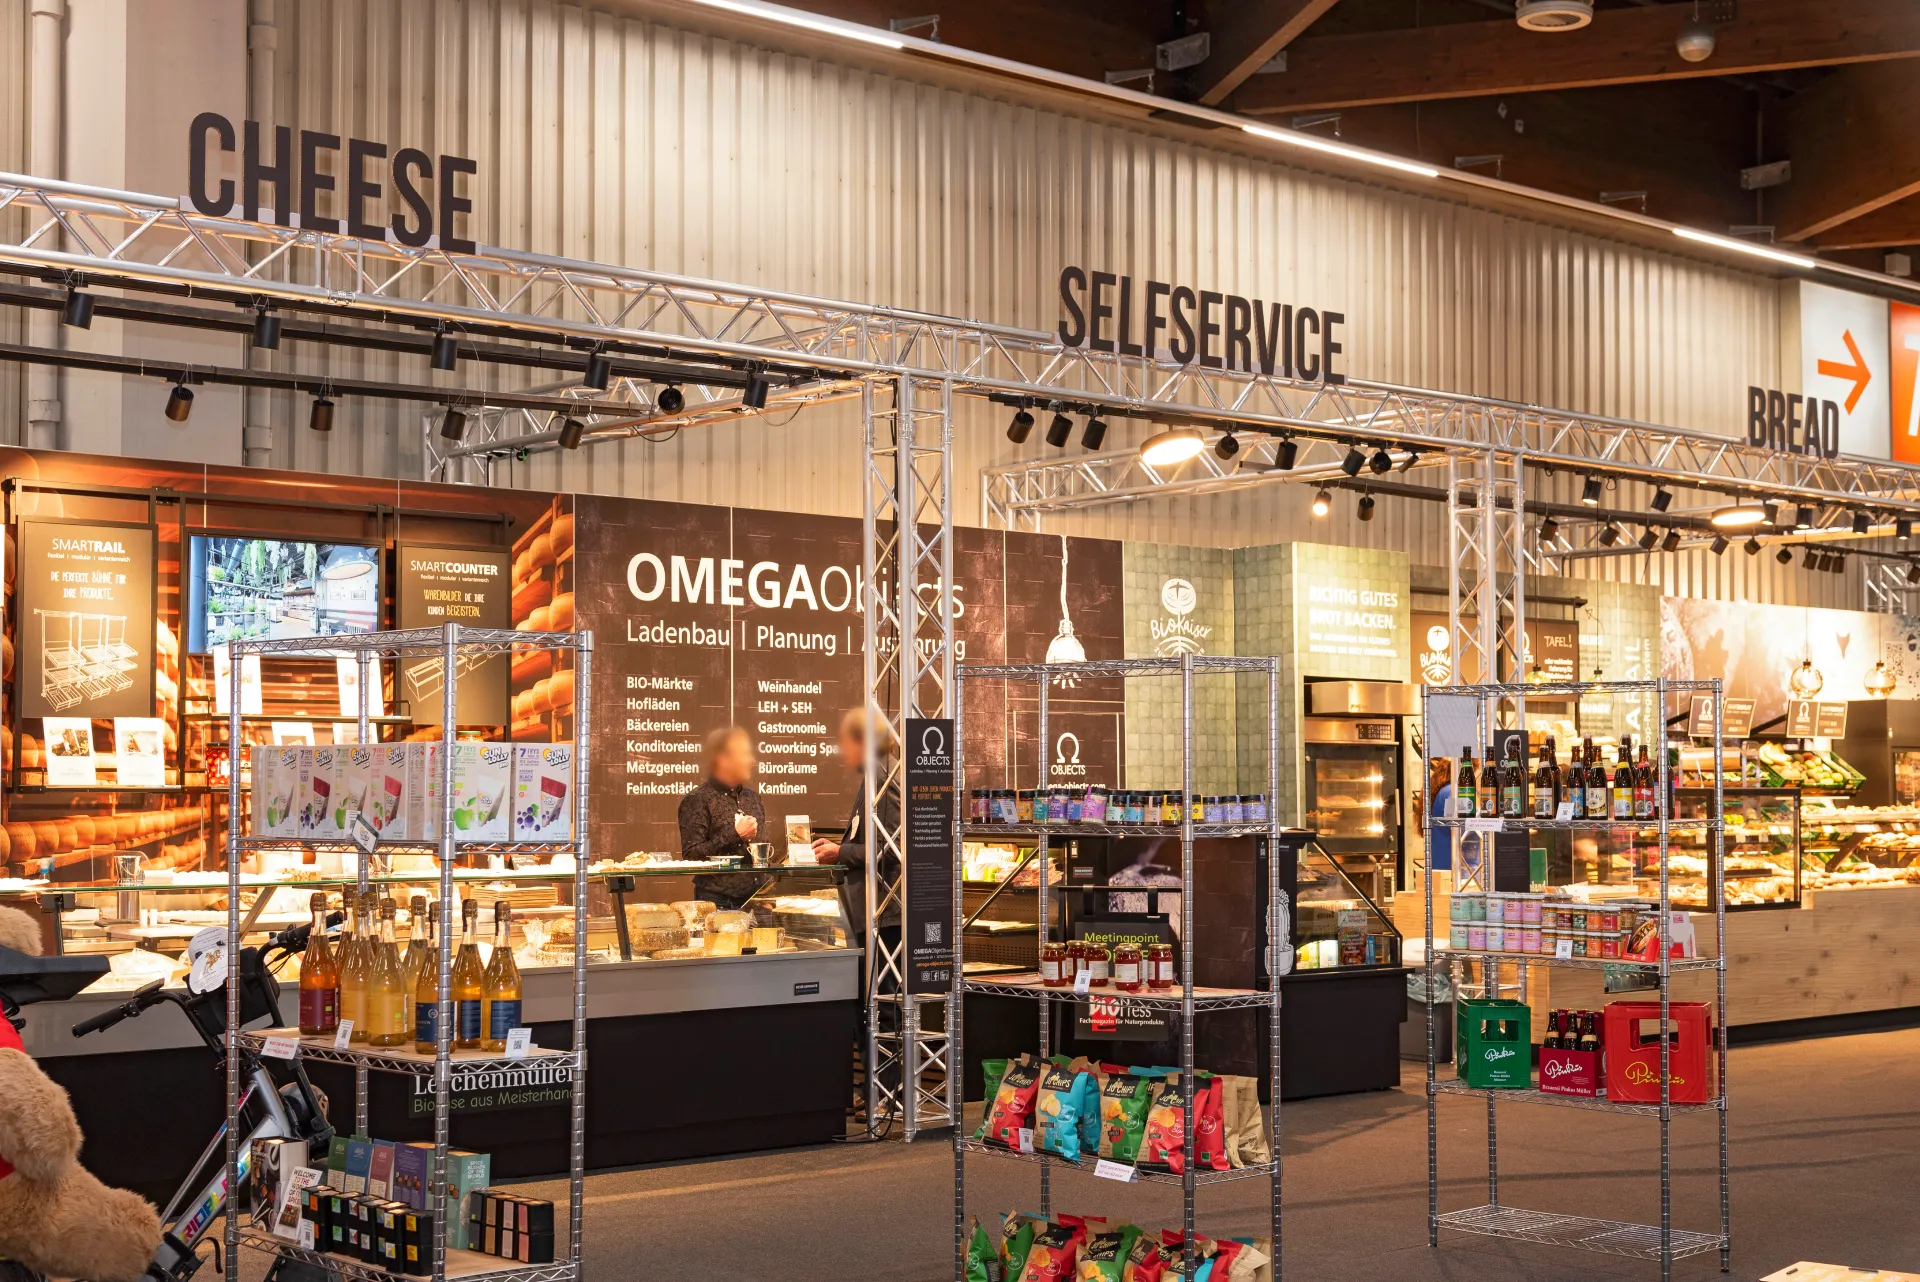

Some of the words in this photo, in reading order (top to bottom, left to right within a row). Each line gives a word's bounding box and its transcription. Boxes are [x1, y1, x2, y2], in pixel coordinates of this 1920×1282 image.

[188, 112, 477, 255] CHEESE
[1058, 265, 1345, 386] SELFSERVICE
[1748, 385, 1839, 459] BREAD
[52, 538, 126, 554] SMARTRAIL
[410, 560, 498, 575] SMARTCOUNTER
[627, 552, 965, 622] OMEGAObjcts
[423, 589, 462, 601] WARENBILDER
[1360, 590, 1398, 608] GUTES
[627, 619, 730, 646] Ladenbau
[757, 625, 837, 657] Planung
[1543, 633, 1573, 649] TAFEL!
[626, 676, 694, 691] BIO-Märkte
[757, 681, 822, 694] Weinhandel
[626, 697, 680, 711] Hofläden
[758, 701, 779, 713] LEH
[791, 702, 812, 714] SEH
[626, 718, 690, 732] Bäckereien
[757, 721, 827, 734] Gastronomie
[484, 747, 502, 759] SUN
[519, 748, 526, 758] 7
[626, 739, 702, 753] Konditoreien
[758, 741, 817, 756] Coworking
[488, 752, 509, 765] LOLLY
[546, 748, 563, 761] SUN
[550, 753, 570, 766] LOLLY
[916, 756, 950, 766] OBJECTS
[626, 762, 700, 777] Metzgereien
[758, 761, 817, 775] Büroräume
[1050, 764, 1086, 775] OBJECTS
[758, 782, 807, 794] Kantinen
[1084, 932, 1159, 944] Meetingpoint
[1079, 1017, 1115, 1026] Fachmagazin
[1124, 1018, 1164, 1026] Naturprodukte
[1544, 1057, 1583, 1079] Pinkus
[414, 1098, 465, 1113] Biose
[470, 1095, 493, 1108] aus
[294, 1169, 316, 1180] WELCOME
